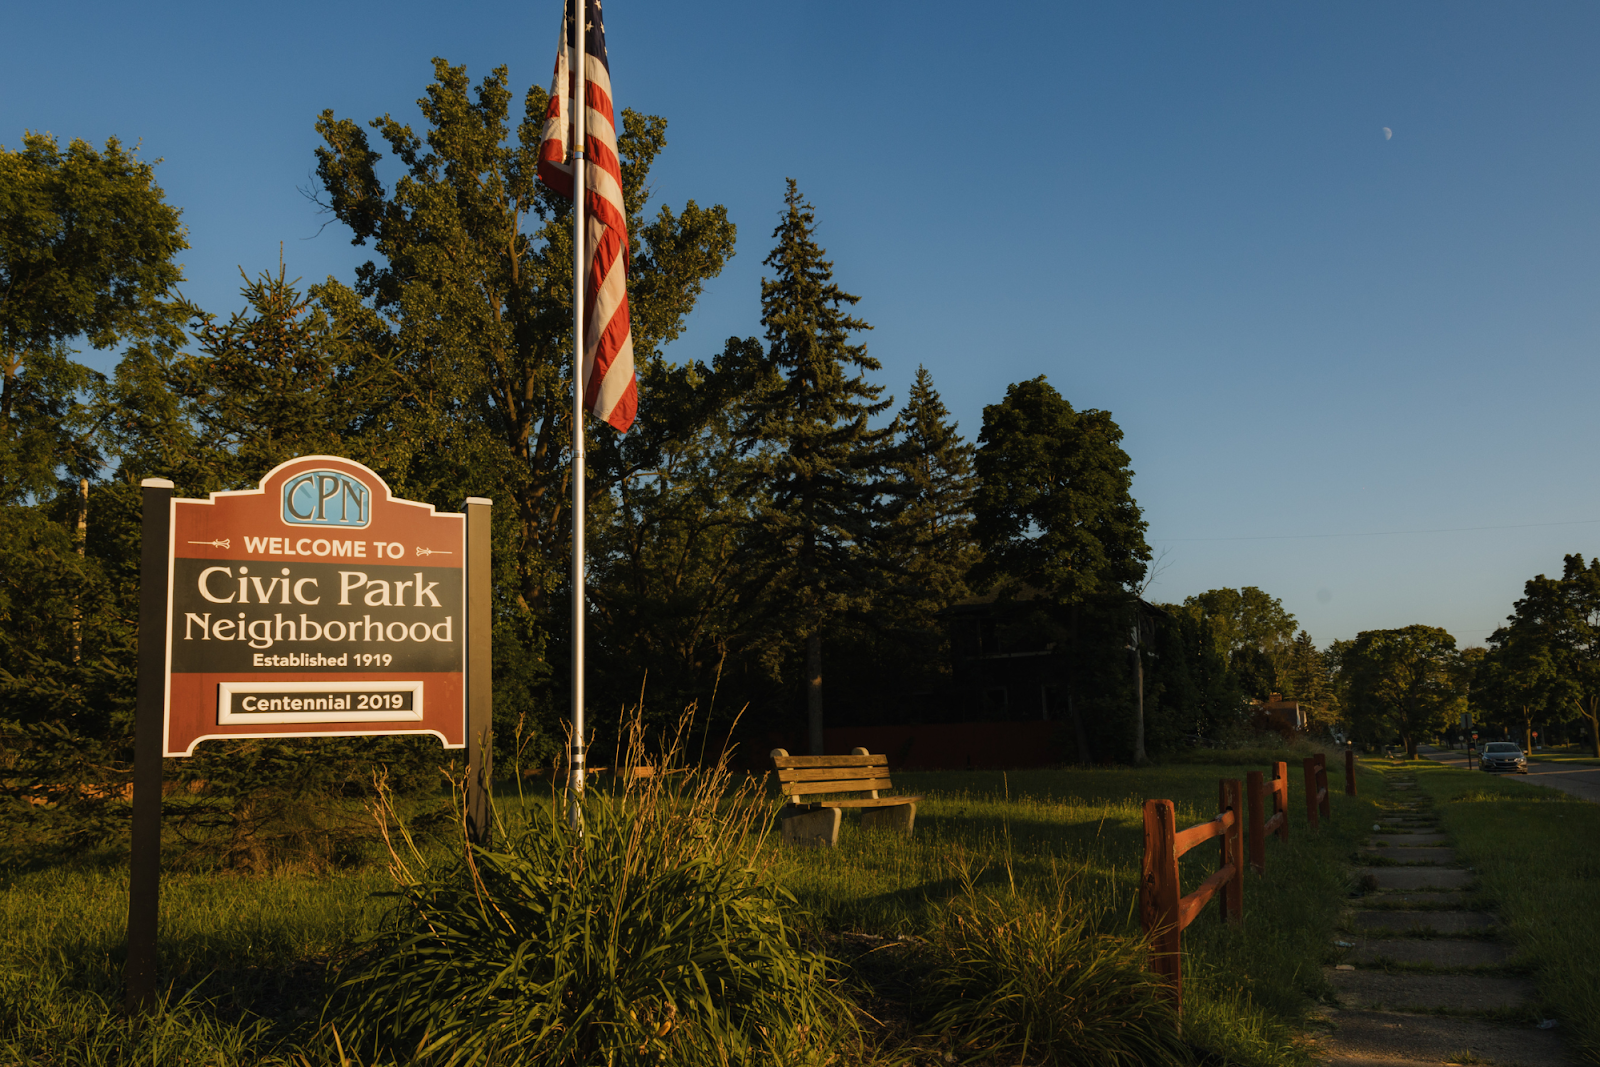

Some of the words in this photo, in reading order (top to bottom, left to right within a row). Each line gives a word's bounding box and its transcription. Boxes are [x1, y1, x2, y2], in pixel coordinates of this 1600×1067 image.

[286, 475, 366, 523] CPN
[244, 537, 366, 558] WELCOME
[373, 542, 404, 559] TO
[198, 566, 320, 605] Civic
[338, 571, 442, 607] Park
[184, 613, 453, 648] Neighborhood
[253, 653, 347, 667] Established
[353, 653, 392, 667] 1919
[242, 695, 350, 712] Centennial
[357, 694, 403, 709] 2019
